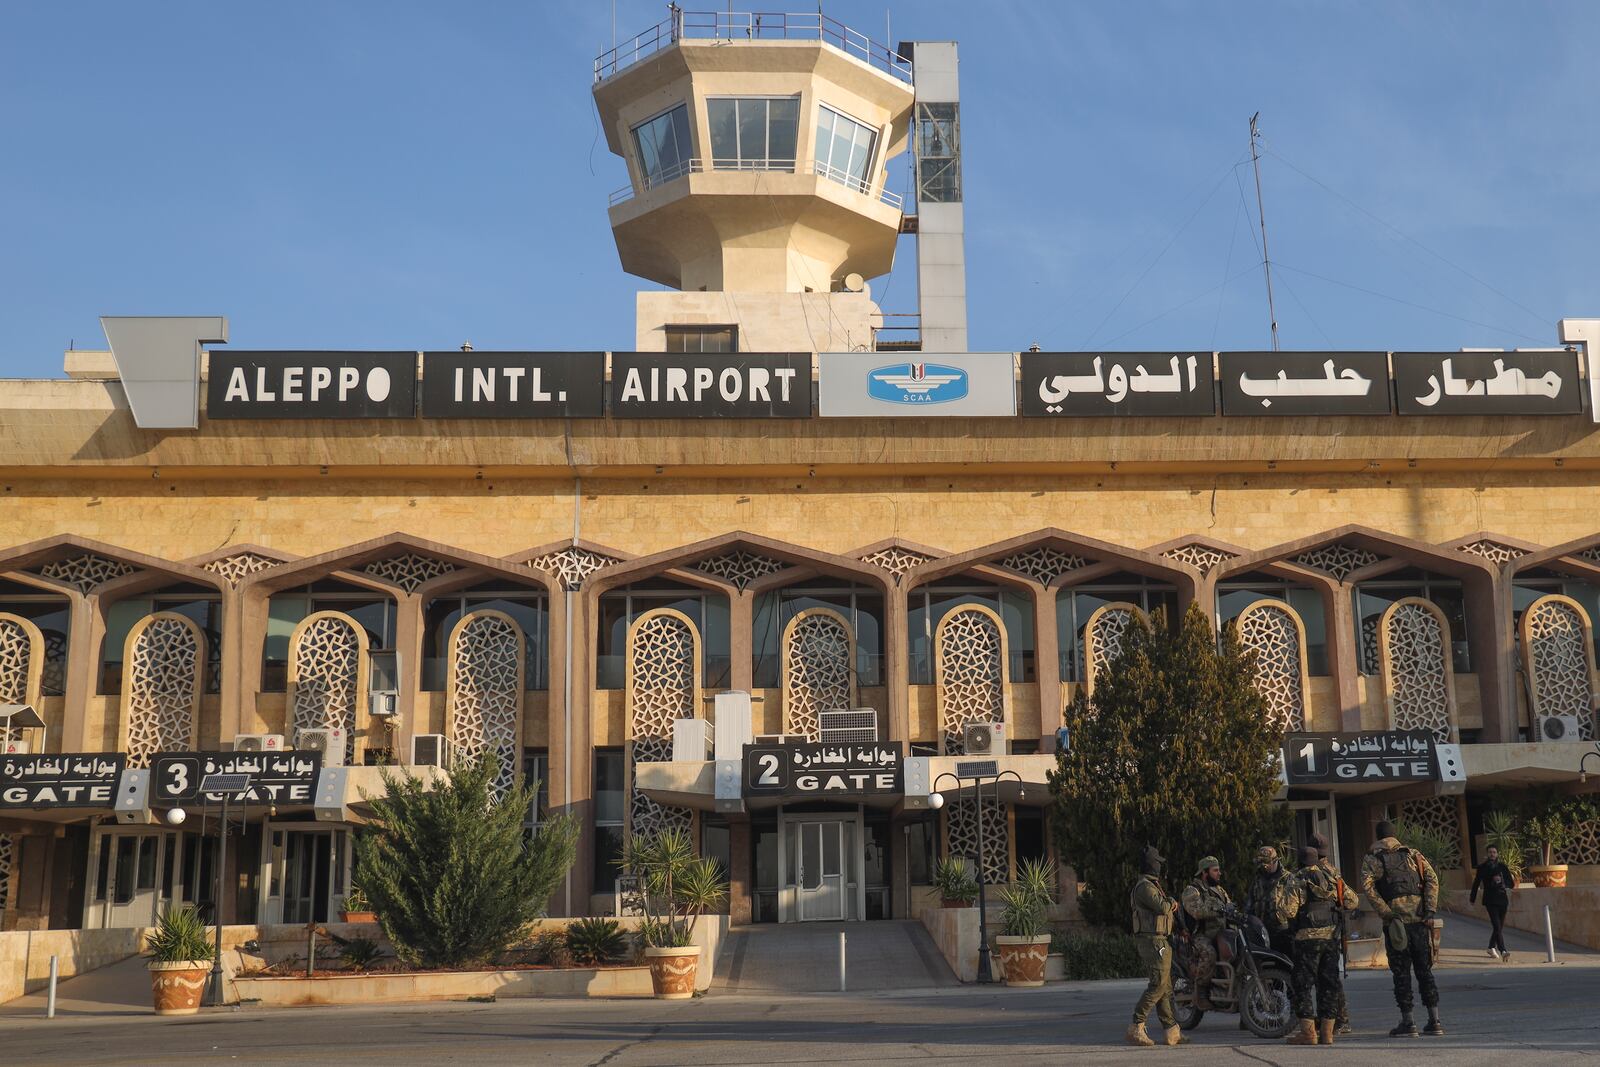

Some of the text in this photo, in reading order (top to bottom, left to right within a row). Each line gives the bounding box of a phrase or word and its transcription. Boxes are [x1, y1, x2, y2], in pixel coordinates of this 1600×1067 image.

[224, 366, 796, 402] ALEPPO INTL. AIRPORT
[1038, 355, 1562, 414] مطار حلب الدولي
[903, 394, 932, 402] SCAA
[1331, 734, 1430, 756] بوابة المغادرة
[204, 755, 314, 776] بوابة المغادرة
[793, 746, 898, 768] بوابة المغادرة
[1299, 742, 1316, 772] 1
[4, 757, 117, 780] بوابة المغادرة
[166, 762, 188, 795] 3
[758, 754, 780, 785] 2
[1335, 761, 1430, 778] GATE
[796, 773, 895, 791] GATE
[2, 786, 112, 803] GATE
